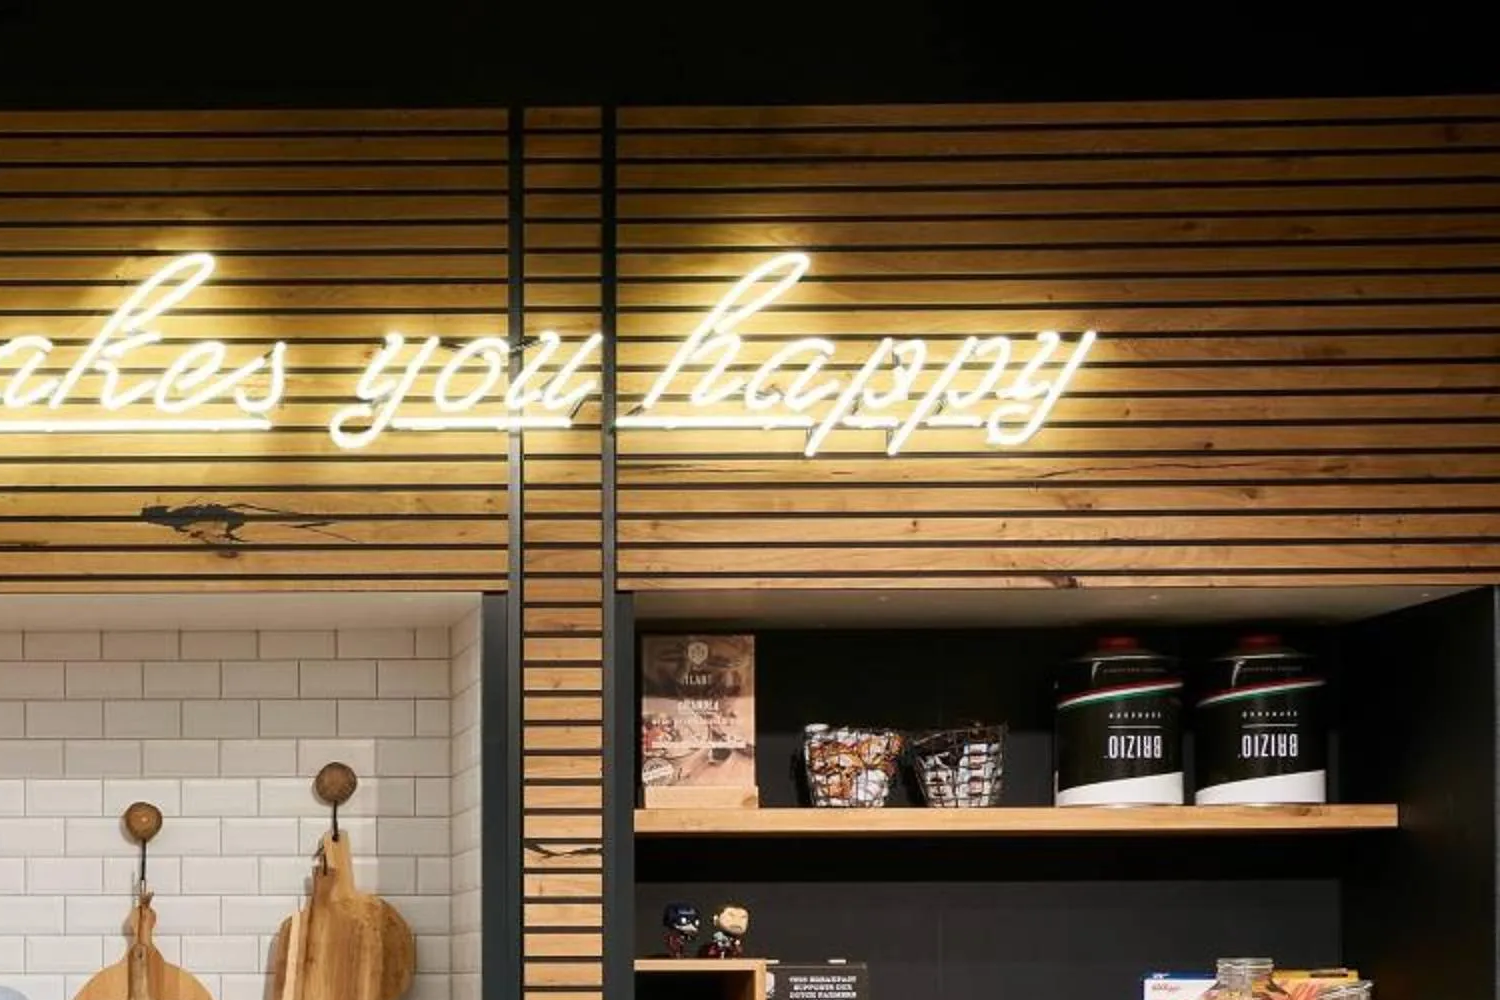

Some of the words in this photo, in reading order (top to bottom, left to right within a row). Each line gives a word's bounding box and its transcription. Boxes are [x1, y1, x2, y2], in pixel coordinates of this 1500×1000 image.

[328, 330, 606, 451] you
[640, 250, 1100, 457] happy
[1108, 735, 1163, 759] BRIZIO
[1240, 733, 1299, 758] BRIZIO
